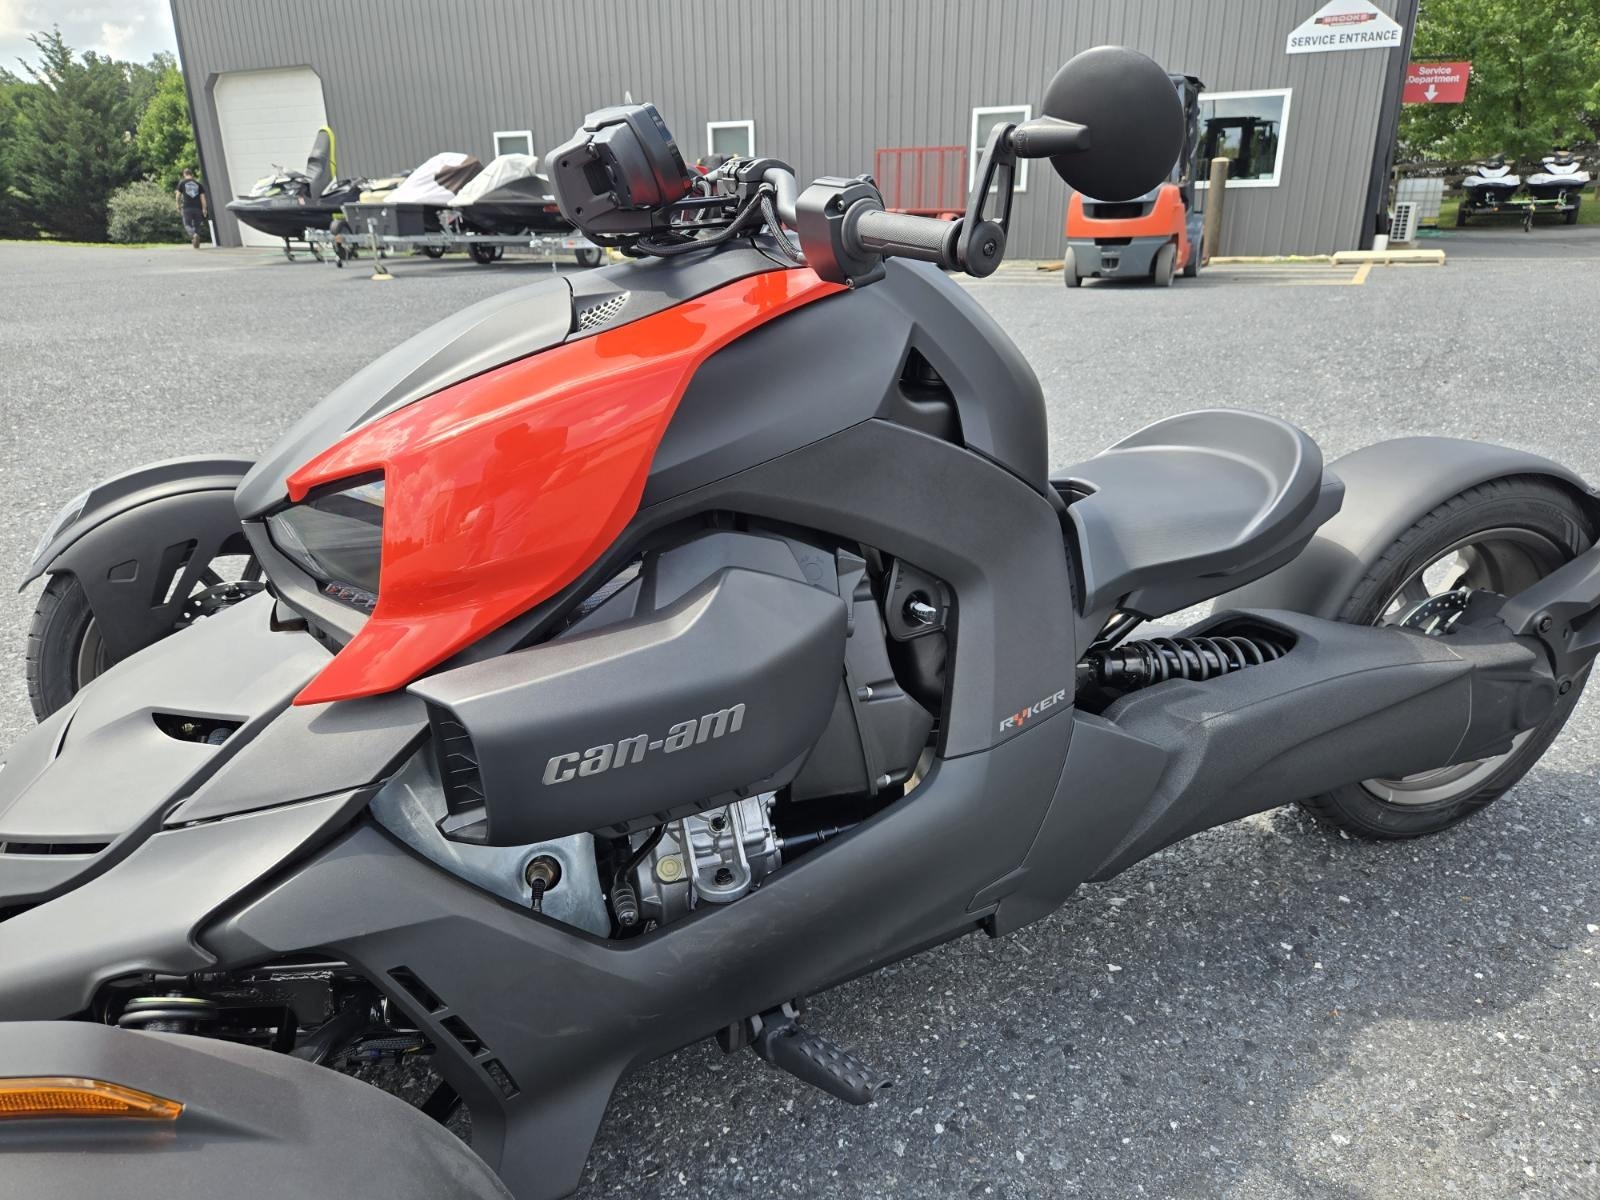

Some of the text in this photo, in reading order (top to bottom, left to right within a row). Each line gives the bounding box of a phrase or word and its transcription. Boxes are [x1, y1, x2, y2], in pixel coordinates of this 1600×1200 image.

[1290, 30, 1399, 47] SERVICE ENTRANCE
[1418, 66, 1452, 75] Service
[1408, 75, 1460, 85] Department
[999, 688, 1066, 732] RYKER
[542, 703, 746, 785] can-am
